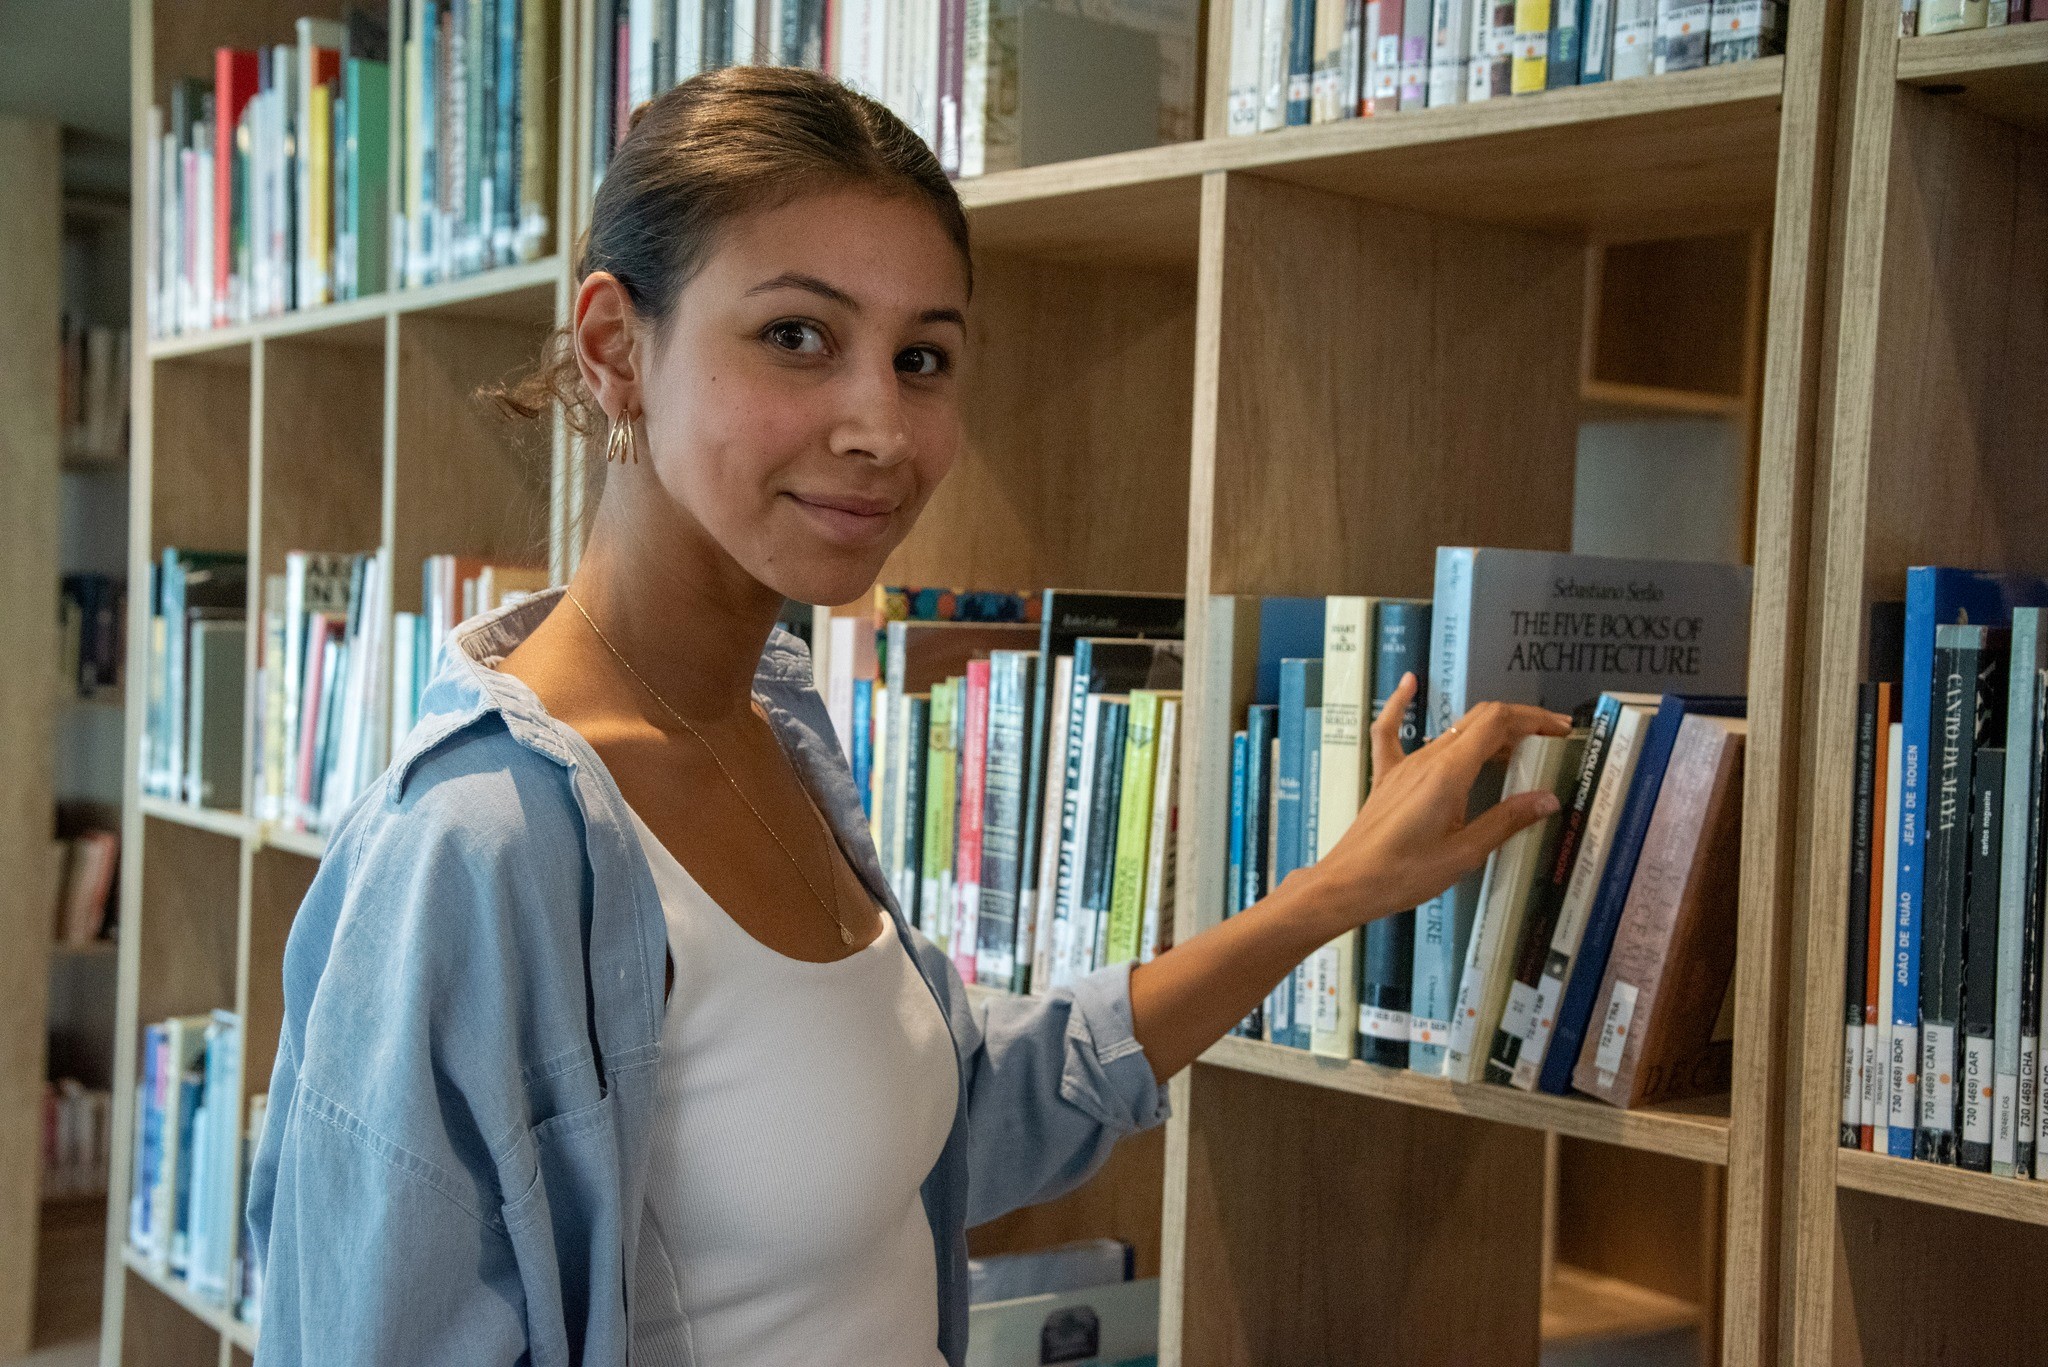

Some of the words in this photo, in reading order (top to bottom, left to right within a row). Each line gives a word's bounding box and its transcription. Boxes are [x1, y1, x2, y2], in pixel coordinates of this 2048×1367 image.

[1627, 581, 1664, 601] Serlio
[1510, 610, 1550, 637] THE
[1551, 611, 1595, 638] FIVE
[1600, 613, 1671, 641] BOOKS
[1673, 616, 1703, 641] OF
[1507, 642, 1700, 674] ARCHITECTURE
[1944, 673, 1963, 740] CANTO
[1596, 713, 1610, 739] THE
[1906, 744, 1918, 784] ROUEN
[1942, 743, 1959, 770] DA
[1574, 738, 1602, 812] EVOLUTION
[1905, 789, 1917, 809] DE
[1939, 776, 1958, 831] MAYA
[1983, 790, 1993, 826] nogueira
[1903, 814, 1916, 846] JEAN
[1981, 827, 1991, 856] carlos
[1900, 892, 1912, 927] RUÃO
[1898, 930, 1911, 948] DE
[1896, 952, 1910, 987] JOÃO
[1894, 1038, 1904, 1064] BOR
[1926, 1043, 1937, 1067] CAN
[1968, 1051, 1979, 1077] CAR
[2022, 1050, 2033, 1078] CHA
[1893, 1067, 1904, 1094] (469)
[1925, 1069, 1937, 1099] (469)
[1968, 1080, 1980, 1107] (469)
[2021, 1079, 2032, 1107] (469)
[1892, 1094, 1902, 1114] 730
[1925, 1100, 1936, 1120] 730
[1967, 1108, 1977, 1127] 730
[2020, 1108, 2031, 1128] 730
